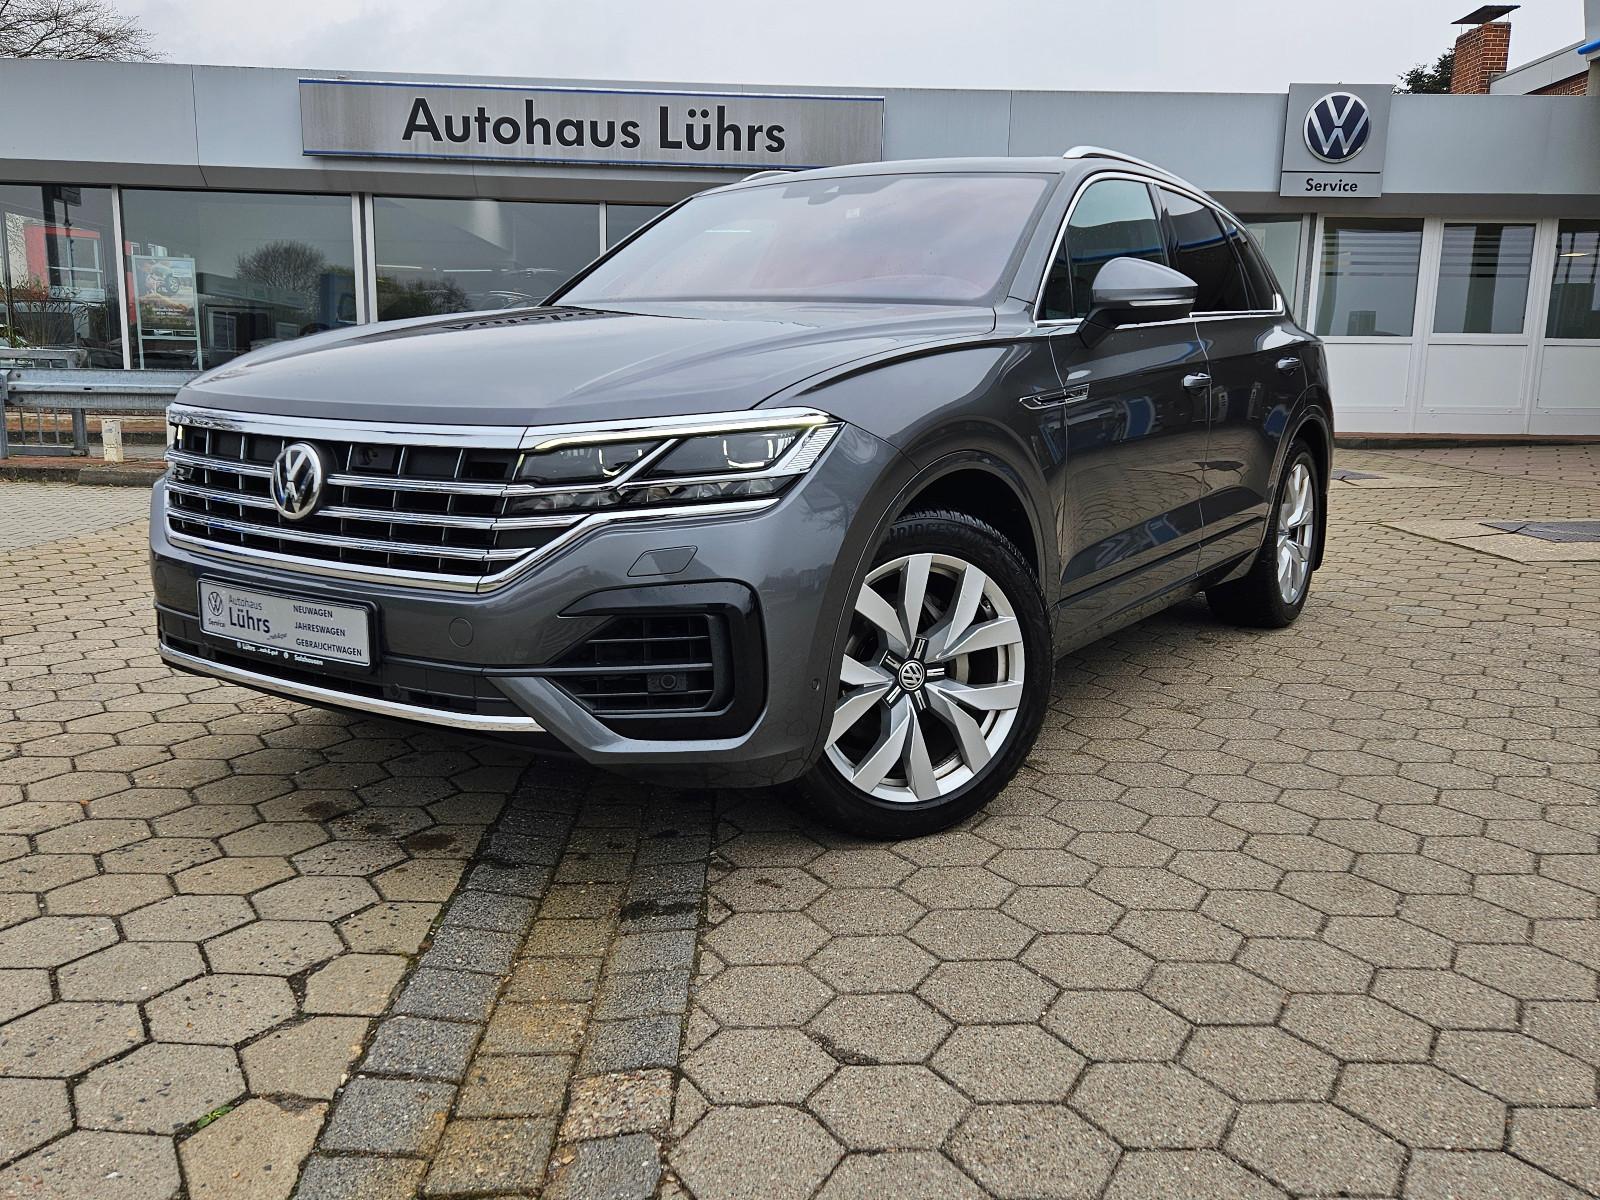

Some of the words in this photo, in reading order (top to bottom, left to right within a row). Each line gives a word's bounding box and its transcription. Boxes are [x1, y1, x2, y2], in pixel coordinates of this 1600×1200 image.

[402, 97, 642, 150] Autohaus
[659, 105, 787, 153] Lührs
[1304, 92, 1370, 162] VW
[1305, 177, 1358, 192] Service
[273, 442, 321, 518] VW
[228, 594, 263, 611] Autohaus
[293, 605, 333, 618] NEUWAGEN
[228, 606, 271, 634] Lührs
[295, 621, 346, 638] JAHRESWAGEN
[295, 638, 362, 657] GEBRAUCHTWAGEN
